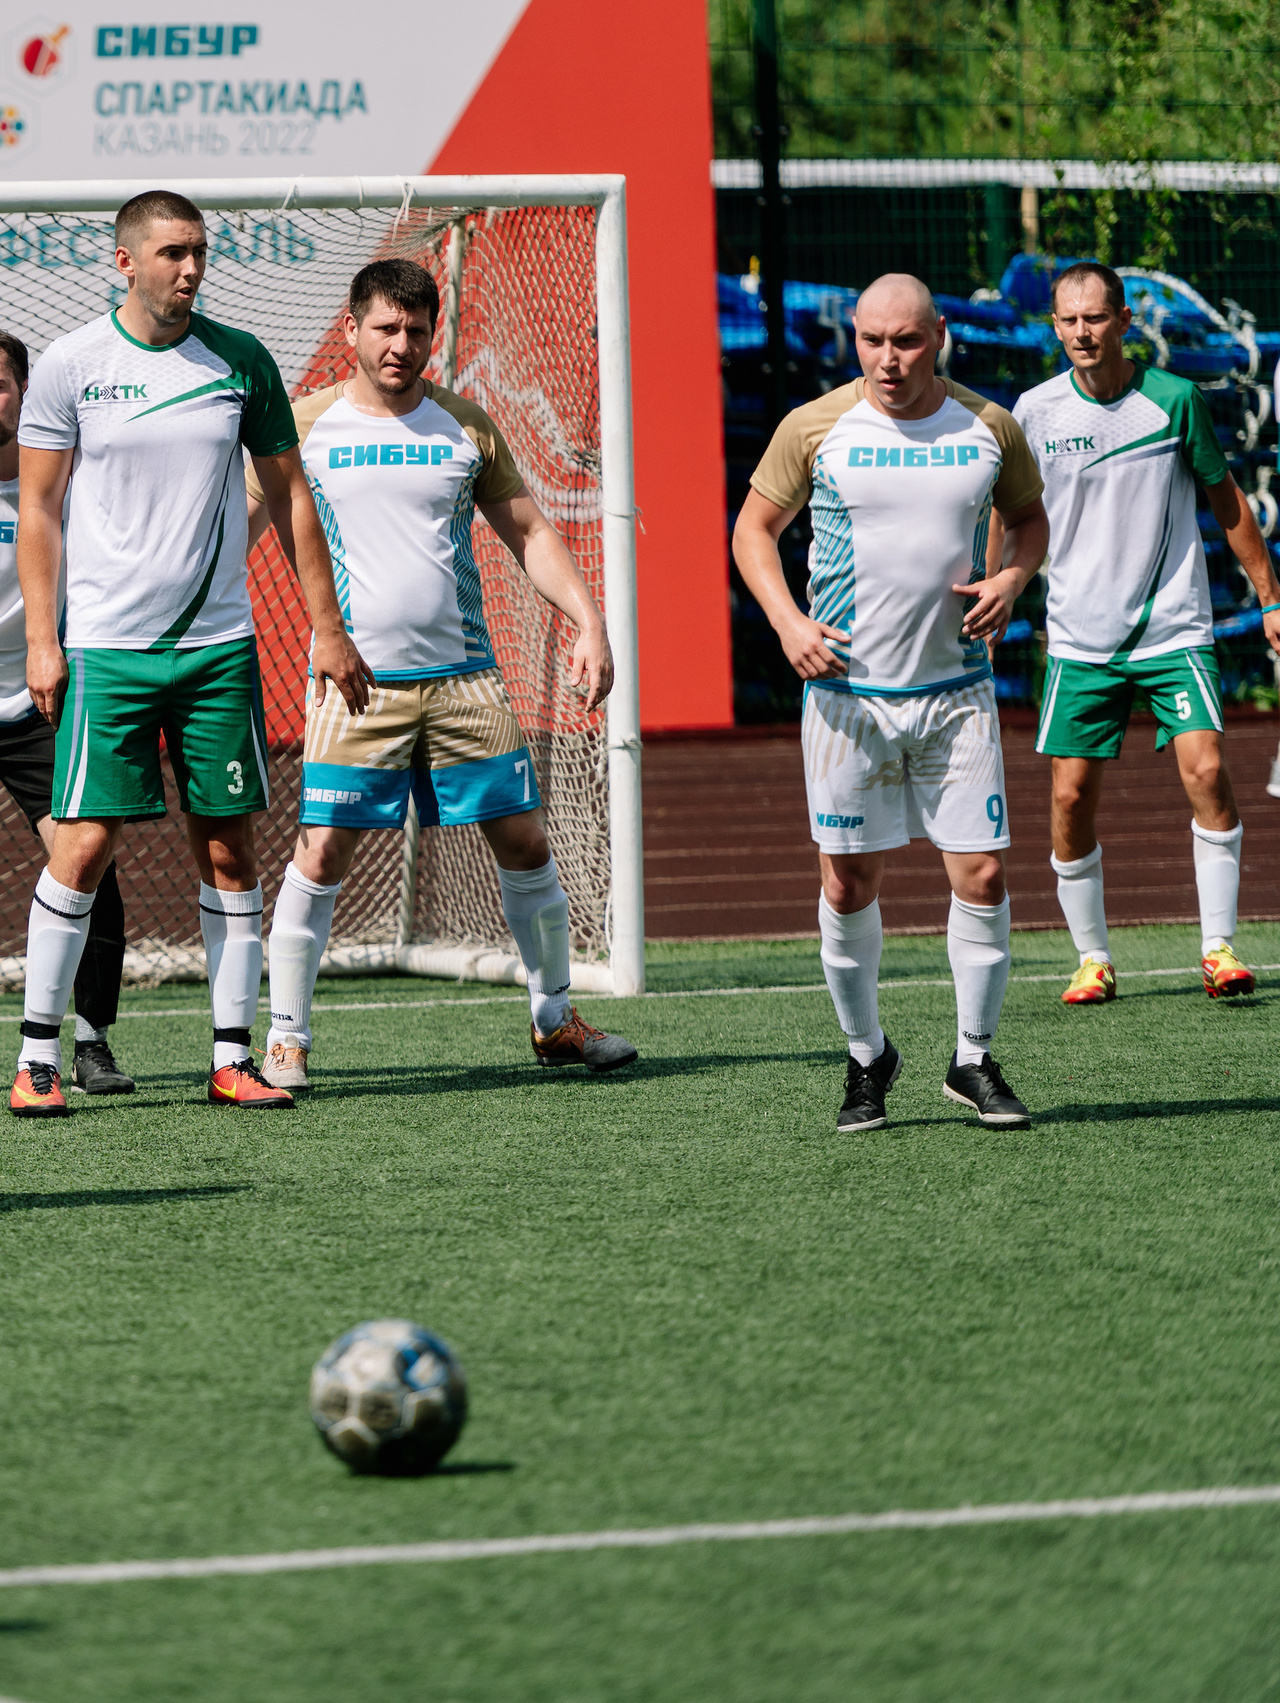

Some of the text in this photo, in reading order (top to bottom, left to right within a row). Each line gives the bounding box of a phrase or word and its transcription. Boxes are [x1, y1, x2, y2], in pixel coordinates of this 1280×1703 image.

[94, 24, 260, 58] СИБУР
[95, 79, 369, 121] СПАРТАКИАДА
[93, 119, 317, 157] КАЗАНЬ 2022
[328, 444, 453, 469] СИБУР
[847, 445, 979, 467] СИБУР
[1174, 690, 1192, 720] 5
[226, 760, 243, 795] 3
[514, 758, 529, 803] 7
[303, 787, 361, 804] СИБУР
[816, 812, 864, 829] ИБУР
[986, 793, 1004, 838] 9
